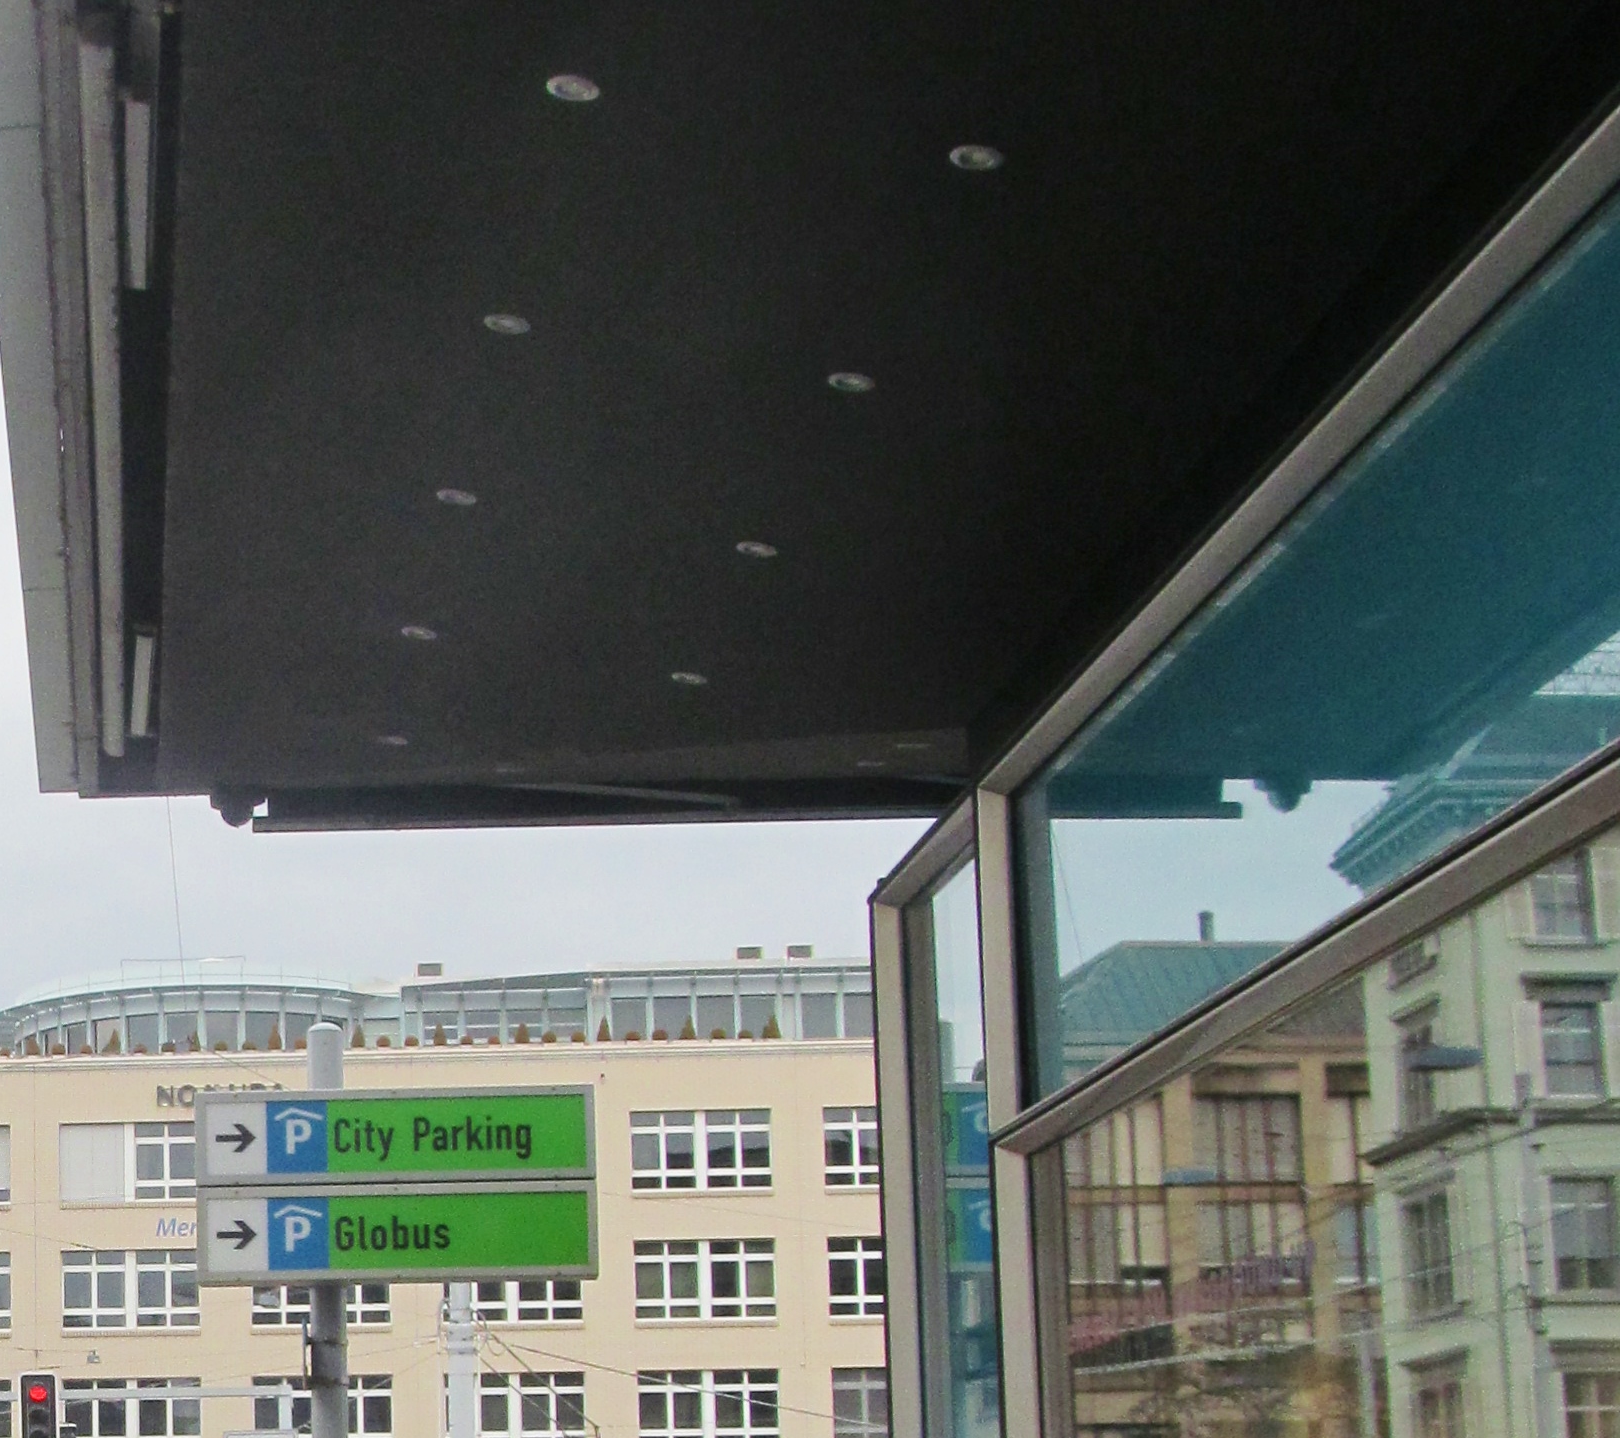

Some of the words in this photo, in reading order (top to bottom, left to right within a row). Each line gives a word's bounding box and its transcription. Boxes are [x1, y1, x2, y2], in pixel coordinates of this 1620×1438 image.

[285, 1118, 312, 1155] P
[333, 1117, 395, 1162] City
[412, 1115, 533, 1160] Parking
[284, 1215, 312, 1253] P
[334, 1214, 452, 1252] Globus
